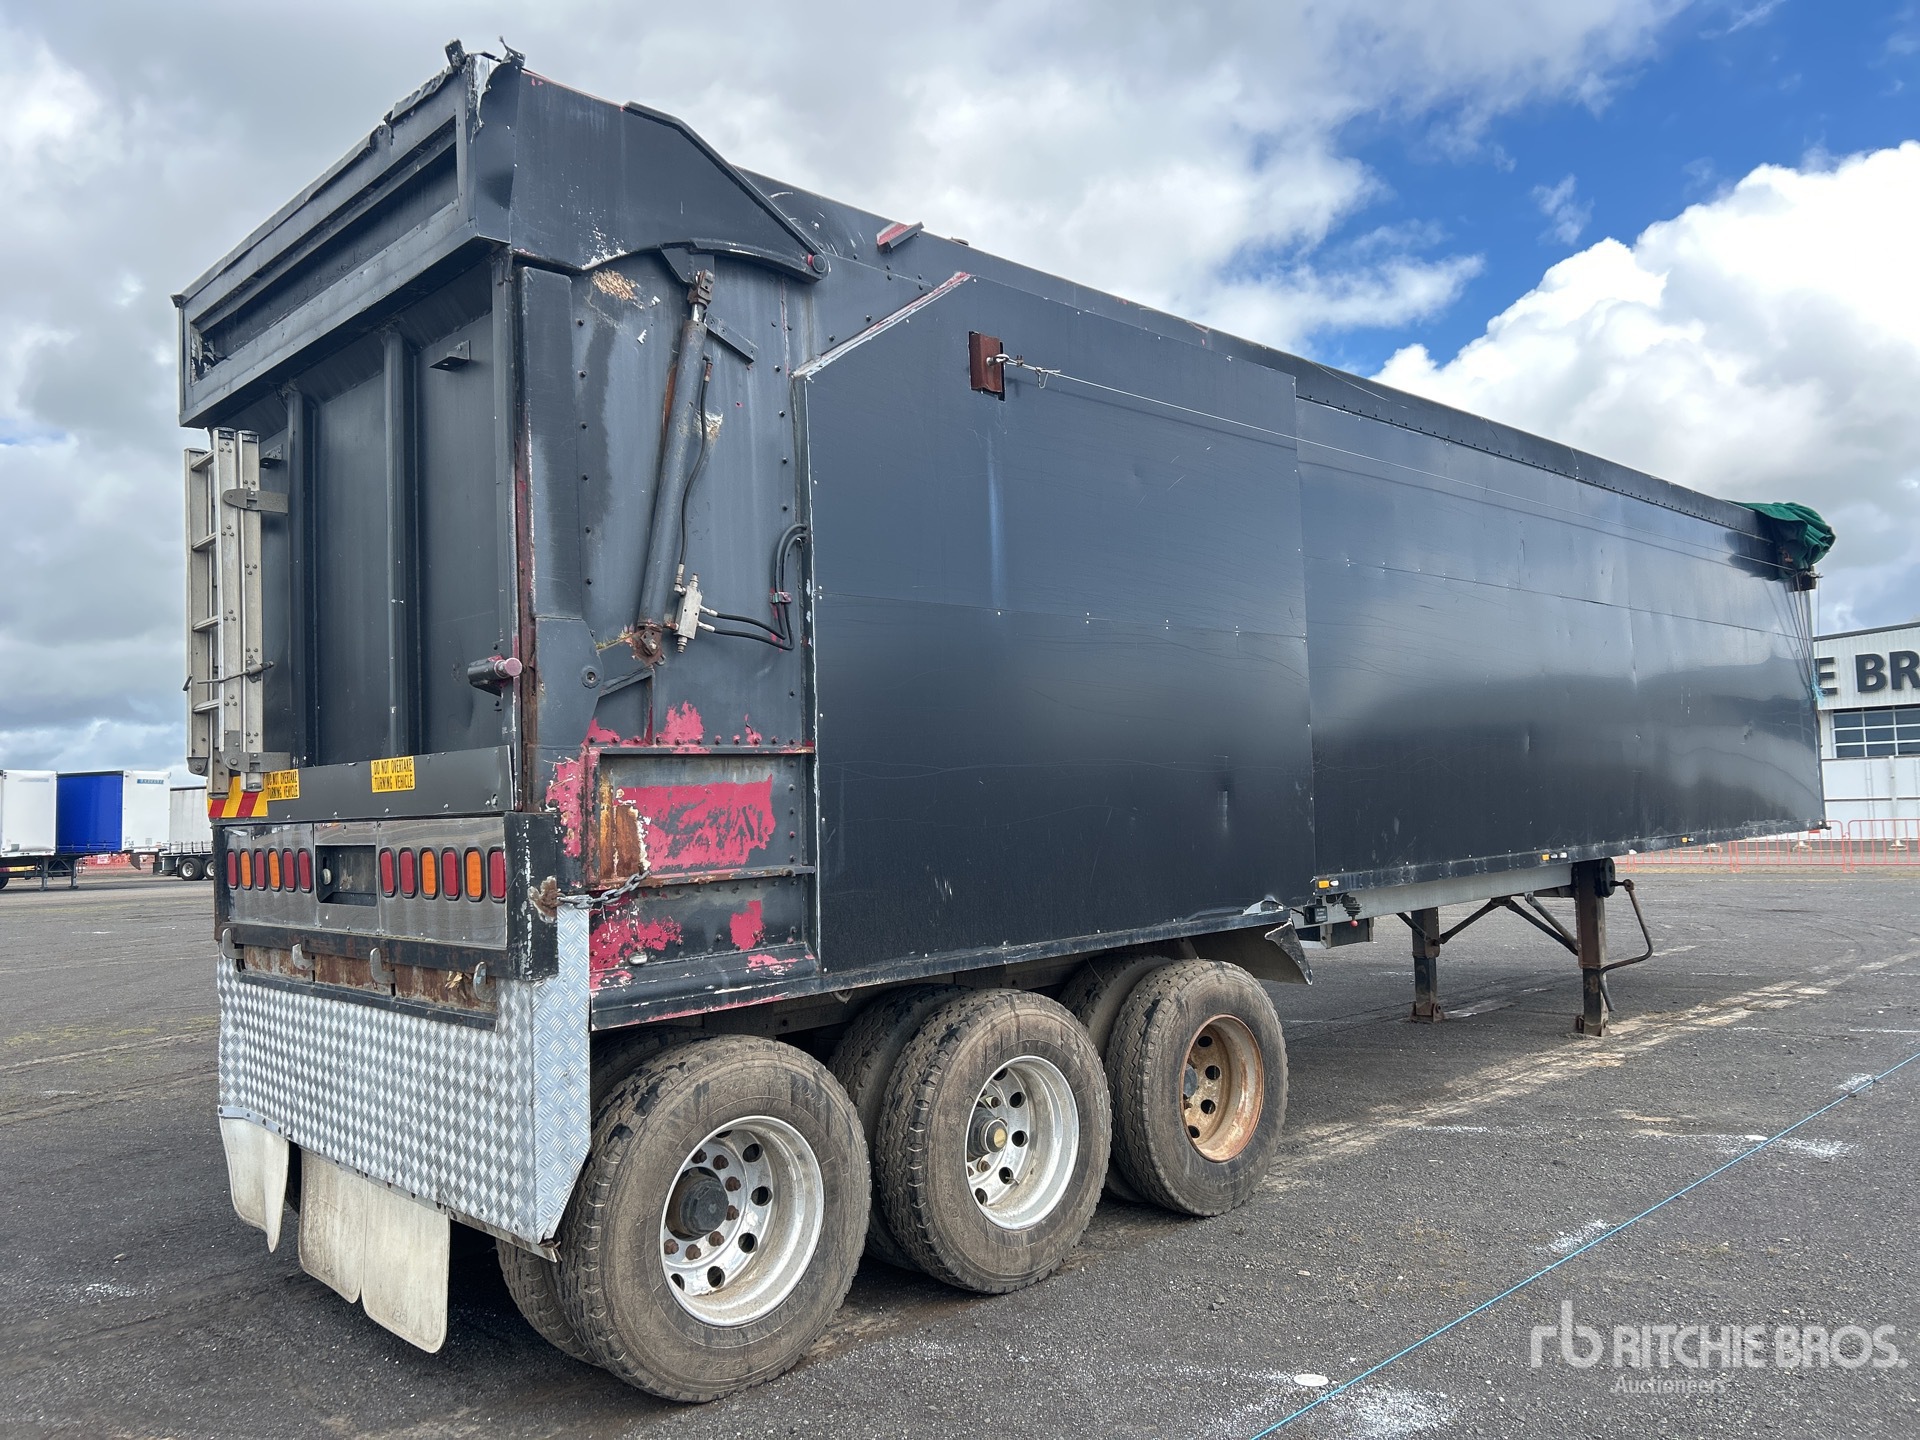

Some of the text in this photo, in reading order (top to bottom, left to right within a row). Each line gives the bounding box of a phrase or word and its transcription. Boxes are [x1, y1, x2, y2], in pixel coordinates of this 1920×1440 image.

[1855, 650, 1920, 693] BR
[373, 757, 413, 775] DO NOT OVERTAKE
[280, 769, 298, 784] OVERTAKE
[374, 774, 414, 790] TURNING VEHICLE
